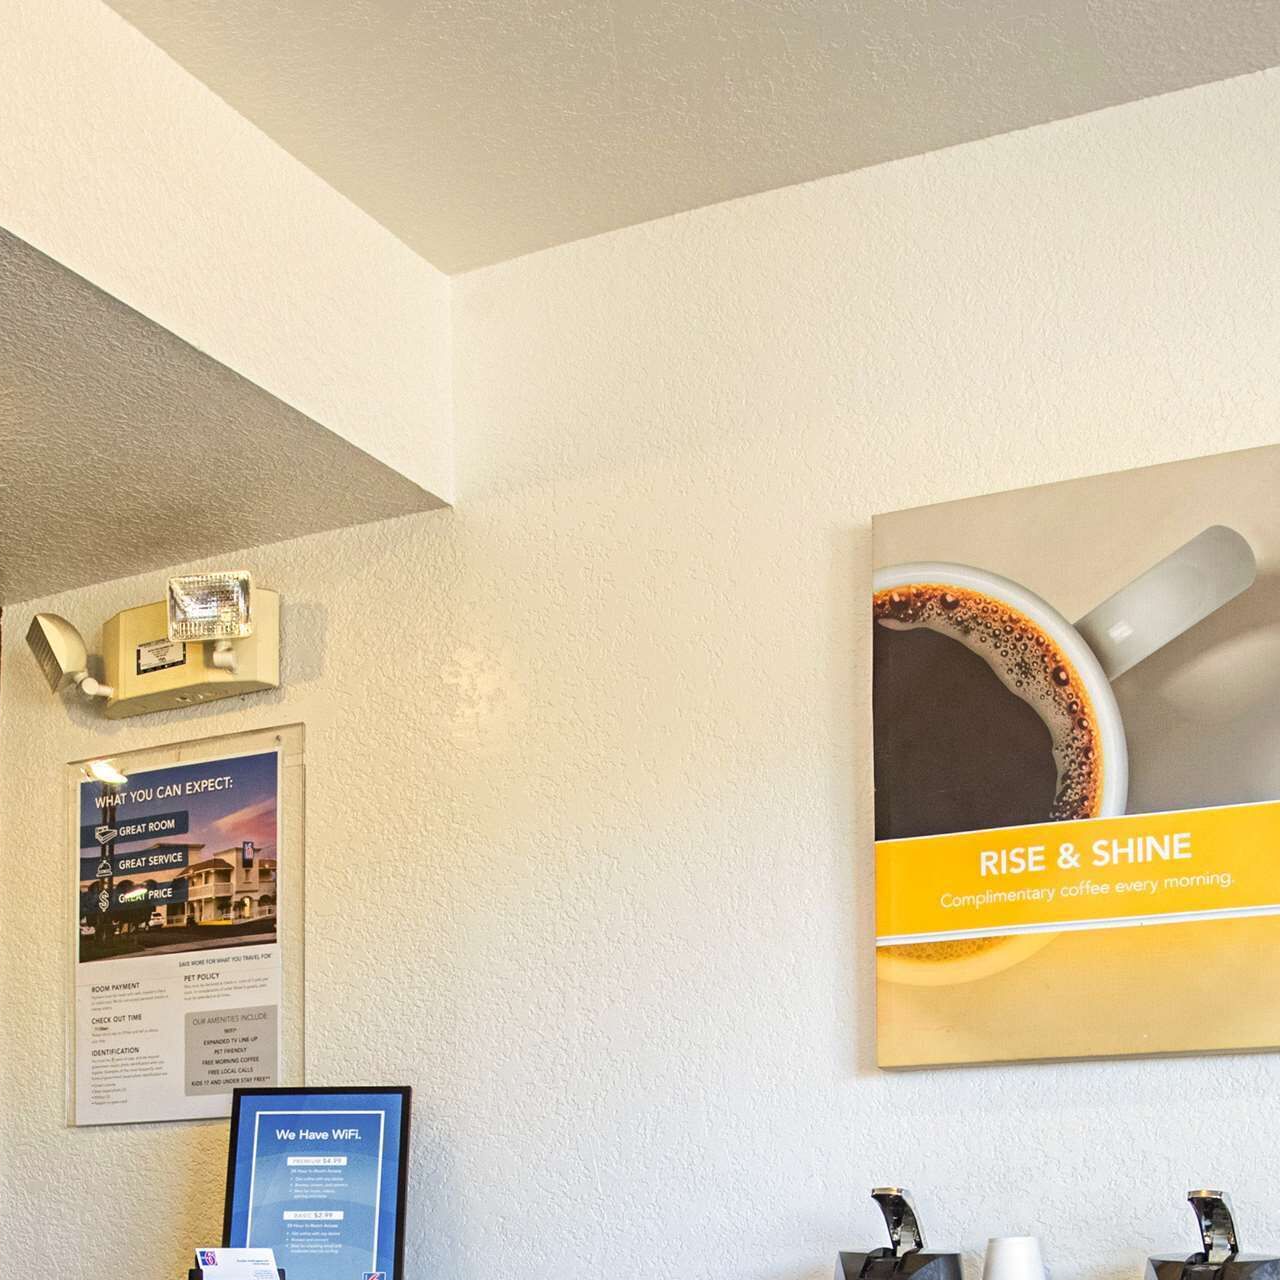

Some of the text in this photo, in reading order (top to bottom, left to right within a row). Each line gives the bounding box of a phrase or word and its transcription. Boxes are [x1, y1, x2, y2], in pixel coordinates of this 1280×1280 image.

[95, 776, 233, 808] WHAT YOU CAN EXPECT:
[119, 819, 175, 836] GREAT ROOM
[980, 832, 1192, 876] RISE & SHINE
[119, 852, 183, 870] GREAT SERVICE
[148, 887, 173, 900] PRICE
[940, 871, 1236, 909] Complimentary coffee every morning.
[196, 972, 219, 980] POLICY
[91, 982, 140, 993] ROOM PAYMENT
[91, 1013, 142, 1024] CHECK OUT TIME
[91, 1047, 140, 1057] IDENTIFICATION
[275, 1128, 362, 1140] We Have WiFi.
